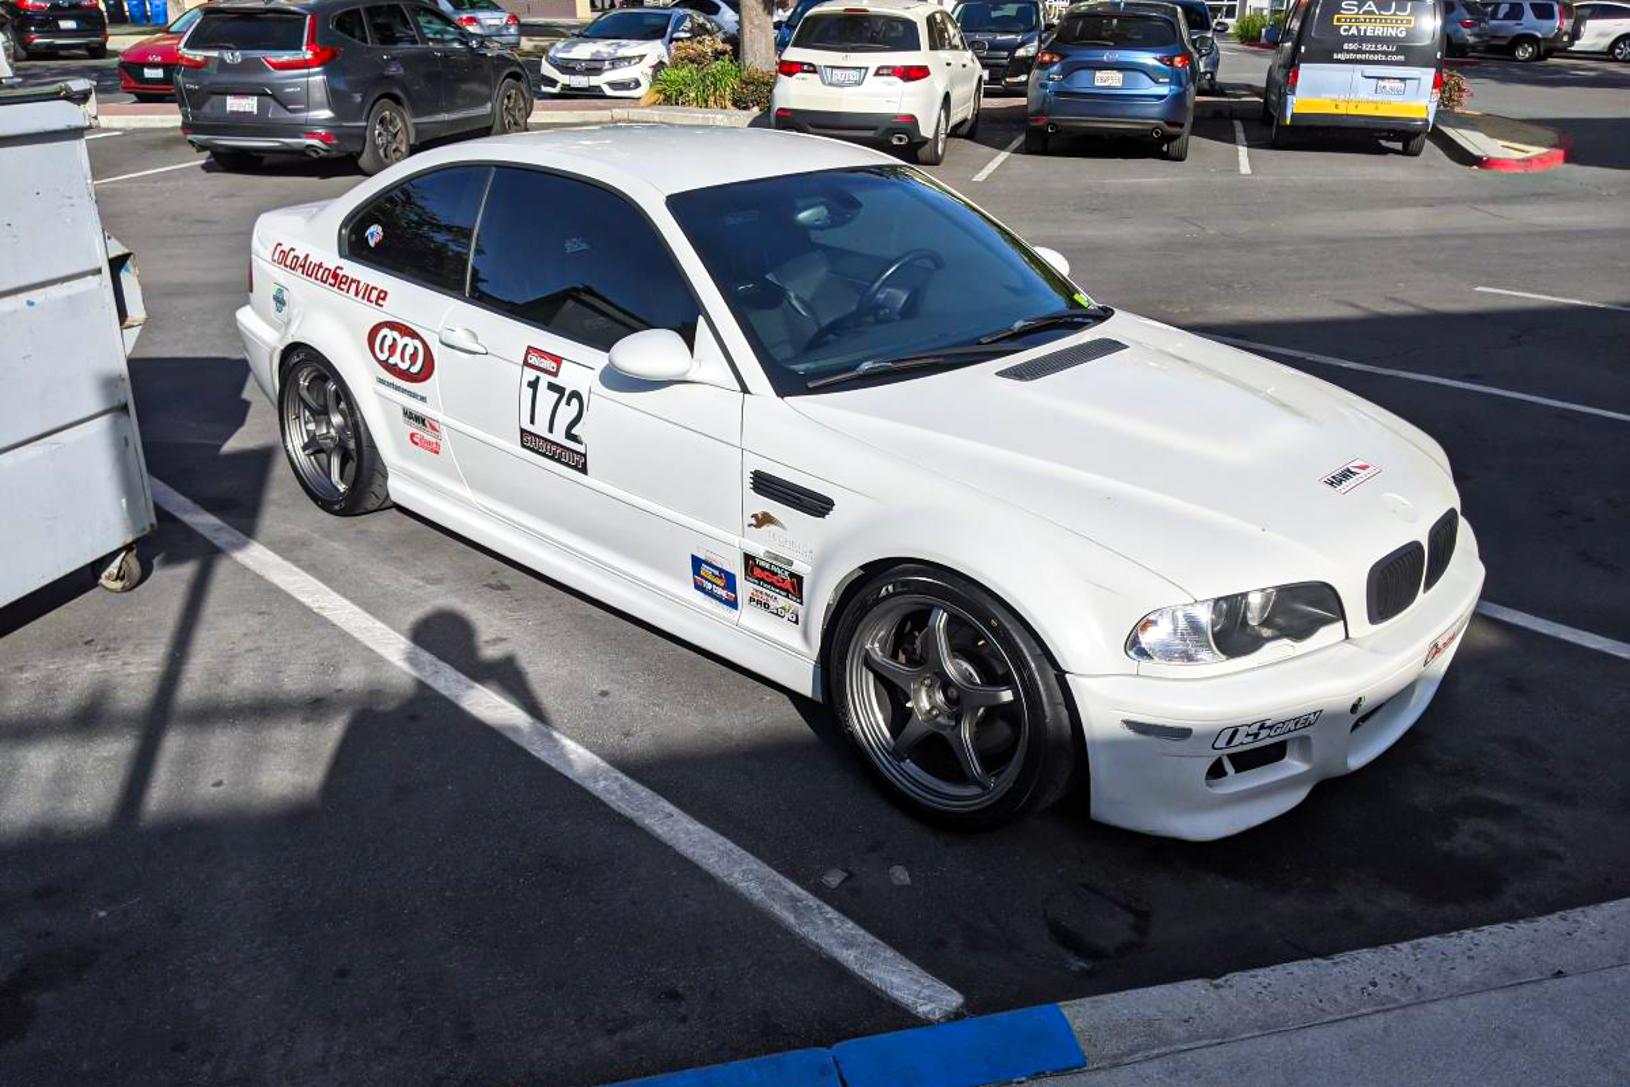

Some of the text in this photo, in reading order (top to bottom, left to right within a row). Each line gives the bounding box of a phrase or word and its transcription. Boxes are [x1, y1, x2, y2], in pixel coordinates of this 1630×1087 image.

[1340, 0, 1411, 15] SAJJ
[1340, 26, 1407, 38] CATERING
[527, 375, 585, 446] 172
[522, 431, 586, 469] SHOOTOUT
[1322, 466, 1361, 489] HAWK
[1268, 709, 1323, 738] GIKEN
